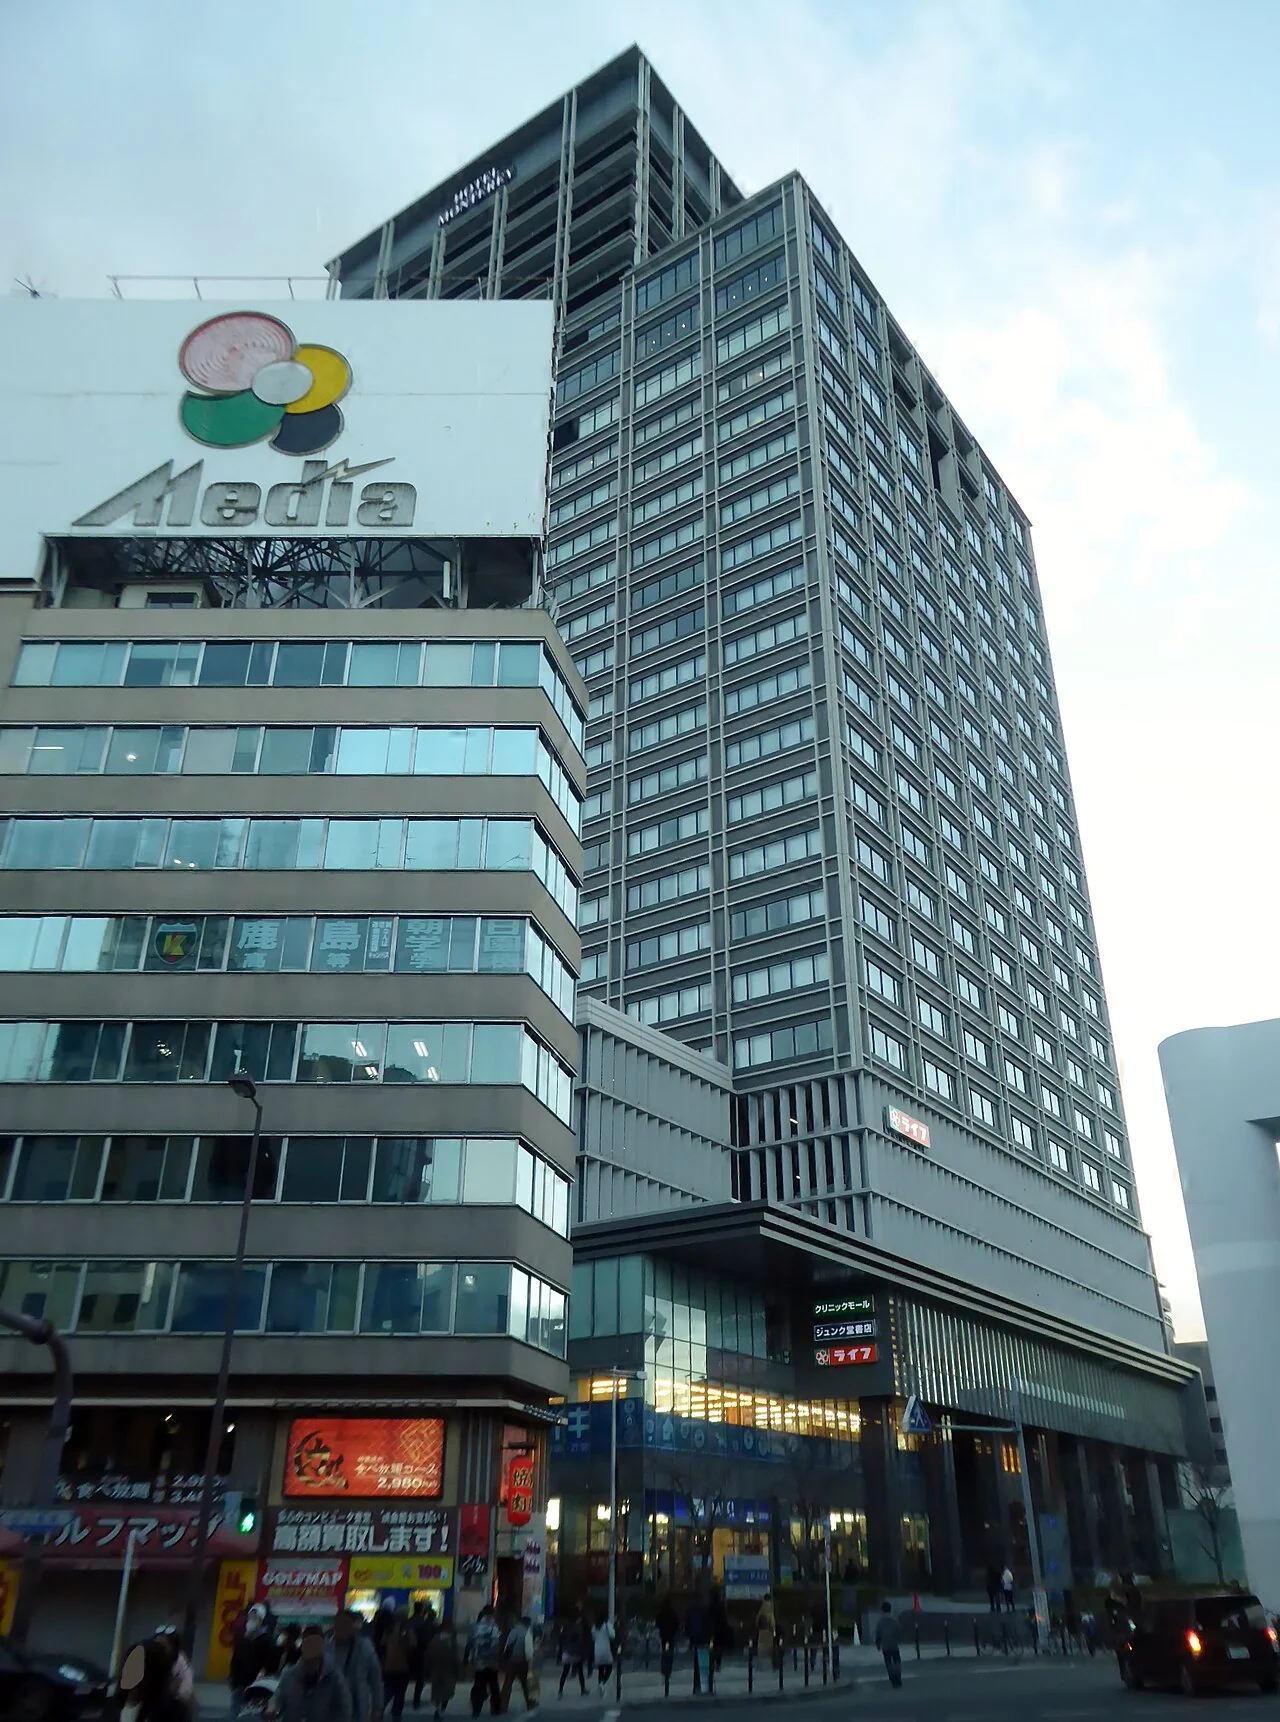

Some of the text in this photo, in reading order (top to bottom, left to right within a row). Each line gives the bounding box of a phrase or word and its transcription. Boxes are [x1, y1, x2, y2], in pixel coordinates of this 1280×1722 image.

[163, 934, 187, 956] K
[901, 1115, 927, 1142] ライフ
[815, 1300, 871, 1314] クリニックモール
[816, 1323, 872, 1337] ジュンク堂書店
[834, 1347, 872, 1362] ライフ
[24, 1513, 223, 1548] ルフマップ
